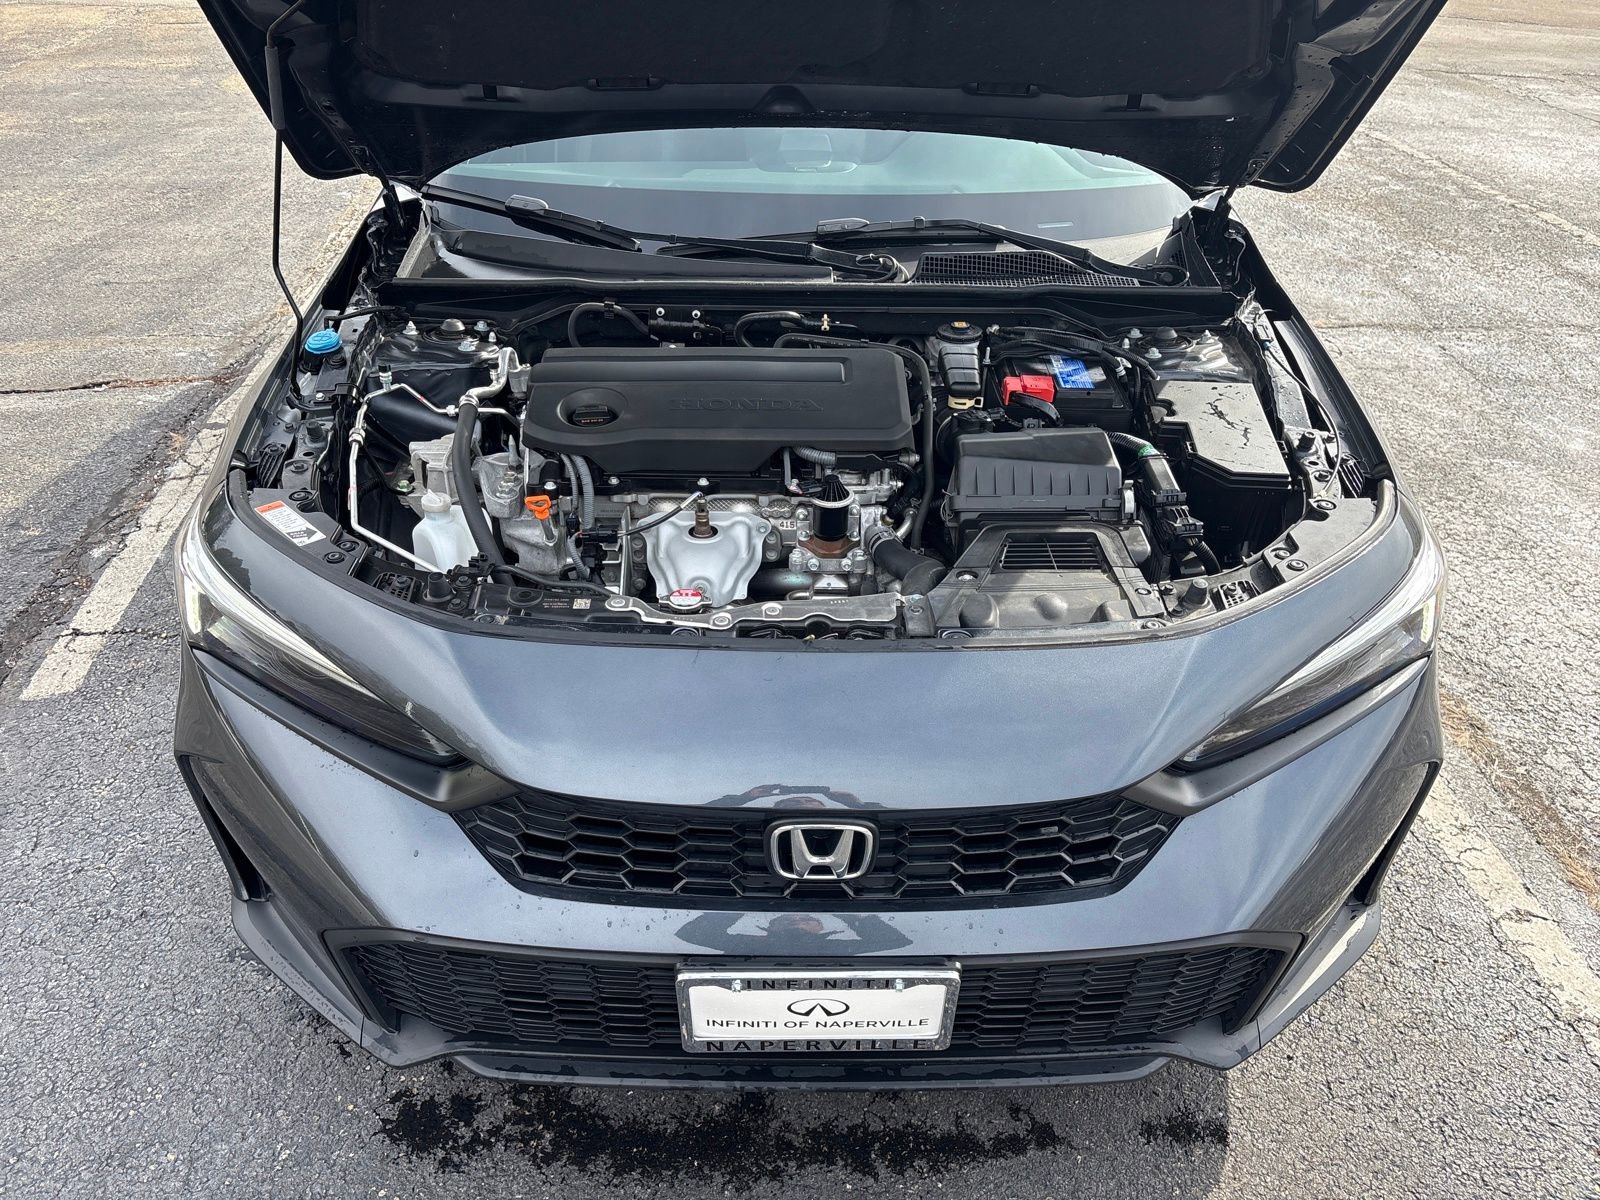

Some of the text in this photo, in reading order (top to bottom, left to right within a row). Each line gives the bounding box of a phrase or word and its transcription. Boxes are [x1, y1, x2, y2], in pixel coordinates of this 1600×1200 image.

[669, 398, 824, 412] HONDA
[746, 980, 890, 989] INFINITI
[706, 1018, 930, 1029] INFINITI OF NAPERVILLE
[706, 1040, 926, 1051] NAPERVILLE
